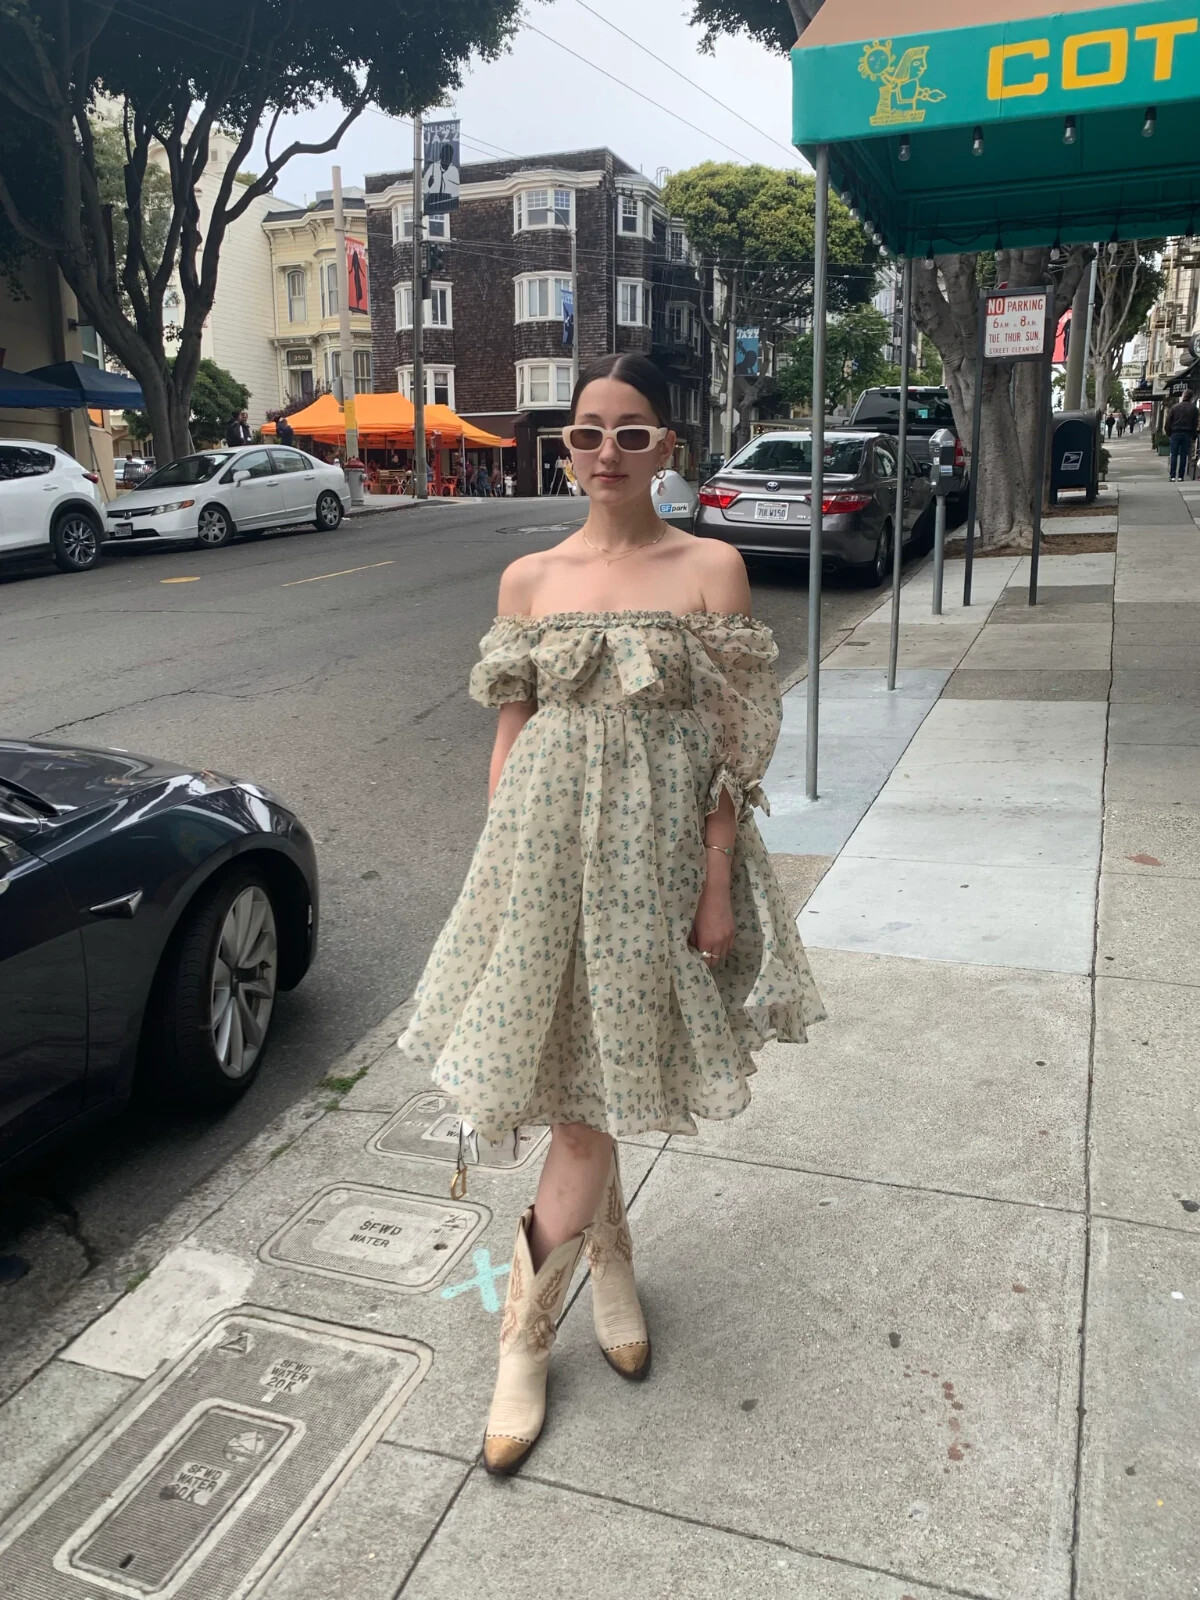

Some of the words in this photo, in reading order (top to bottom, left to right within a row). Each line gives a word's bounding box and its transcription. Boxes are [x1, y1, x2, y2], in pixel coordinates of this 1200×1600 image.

[987, 18, 1198, 100] COT
[424, 129, 460, 144] JAZZ
[988, 298, 1004, 315] NO
[1007, 299, 1043, 312] PARKING
[989, 346, 1009, 354] STREET
[1012, 345, 1040, 353] CLEANING
[360, 1220, 403, 1236] SFWD
[349, 1233, 390, 1248] WATER
[271, 1366, 309, 1383] WATER
[280, 1360, 313, 1373] SFWD
[187, 1464, 223, 1481] SFWD
[177, 1472, 218, 1493] WATER
